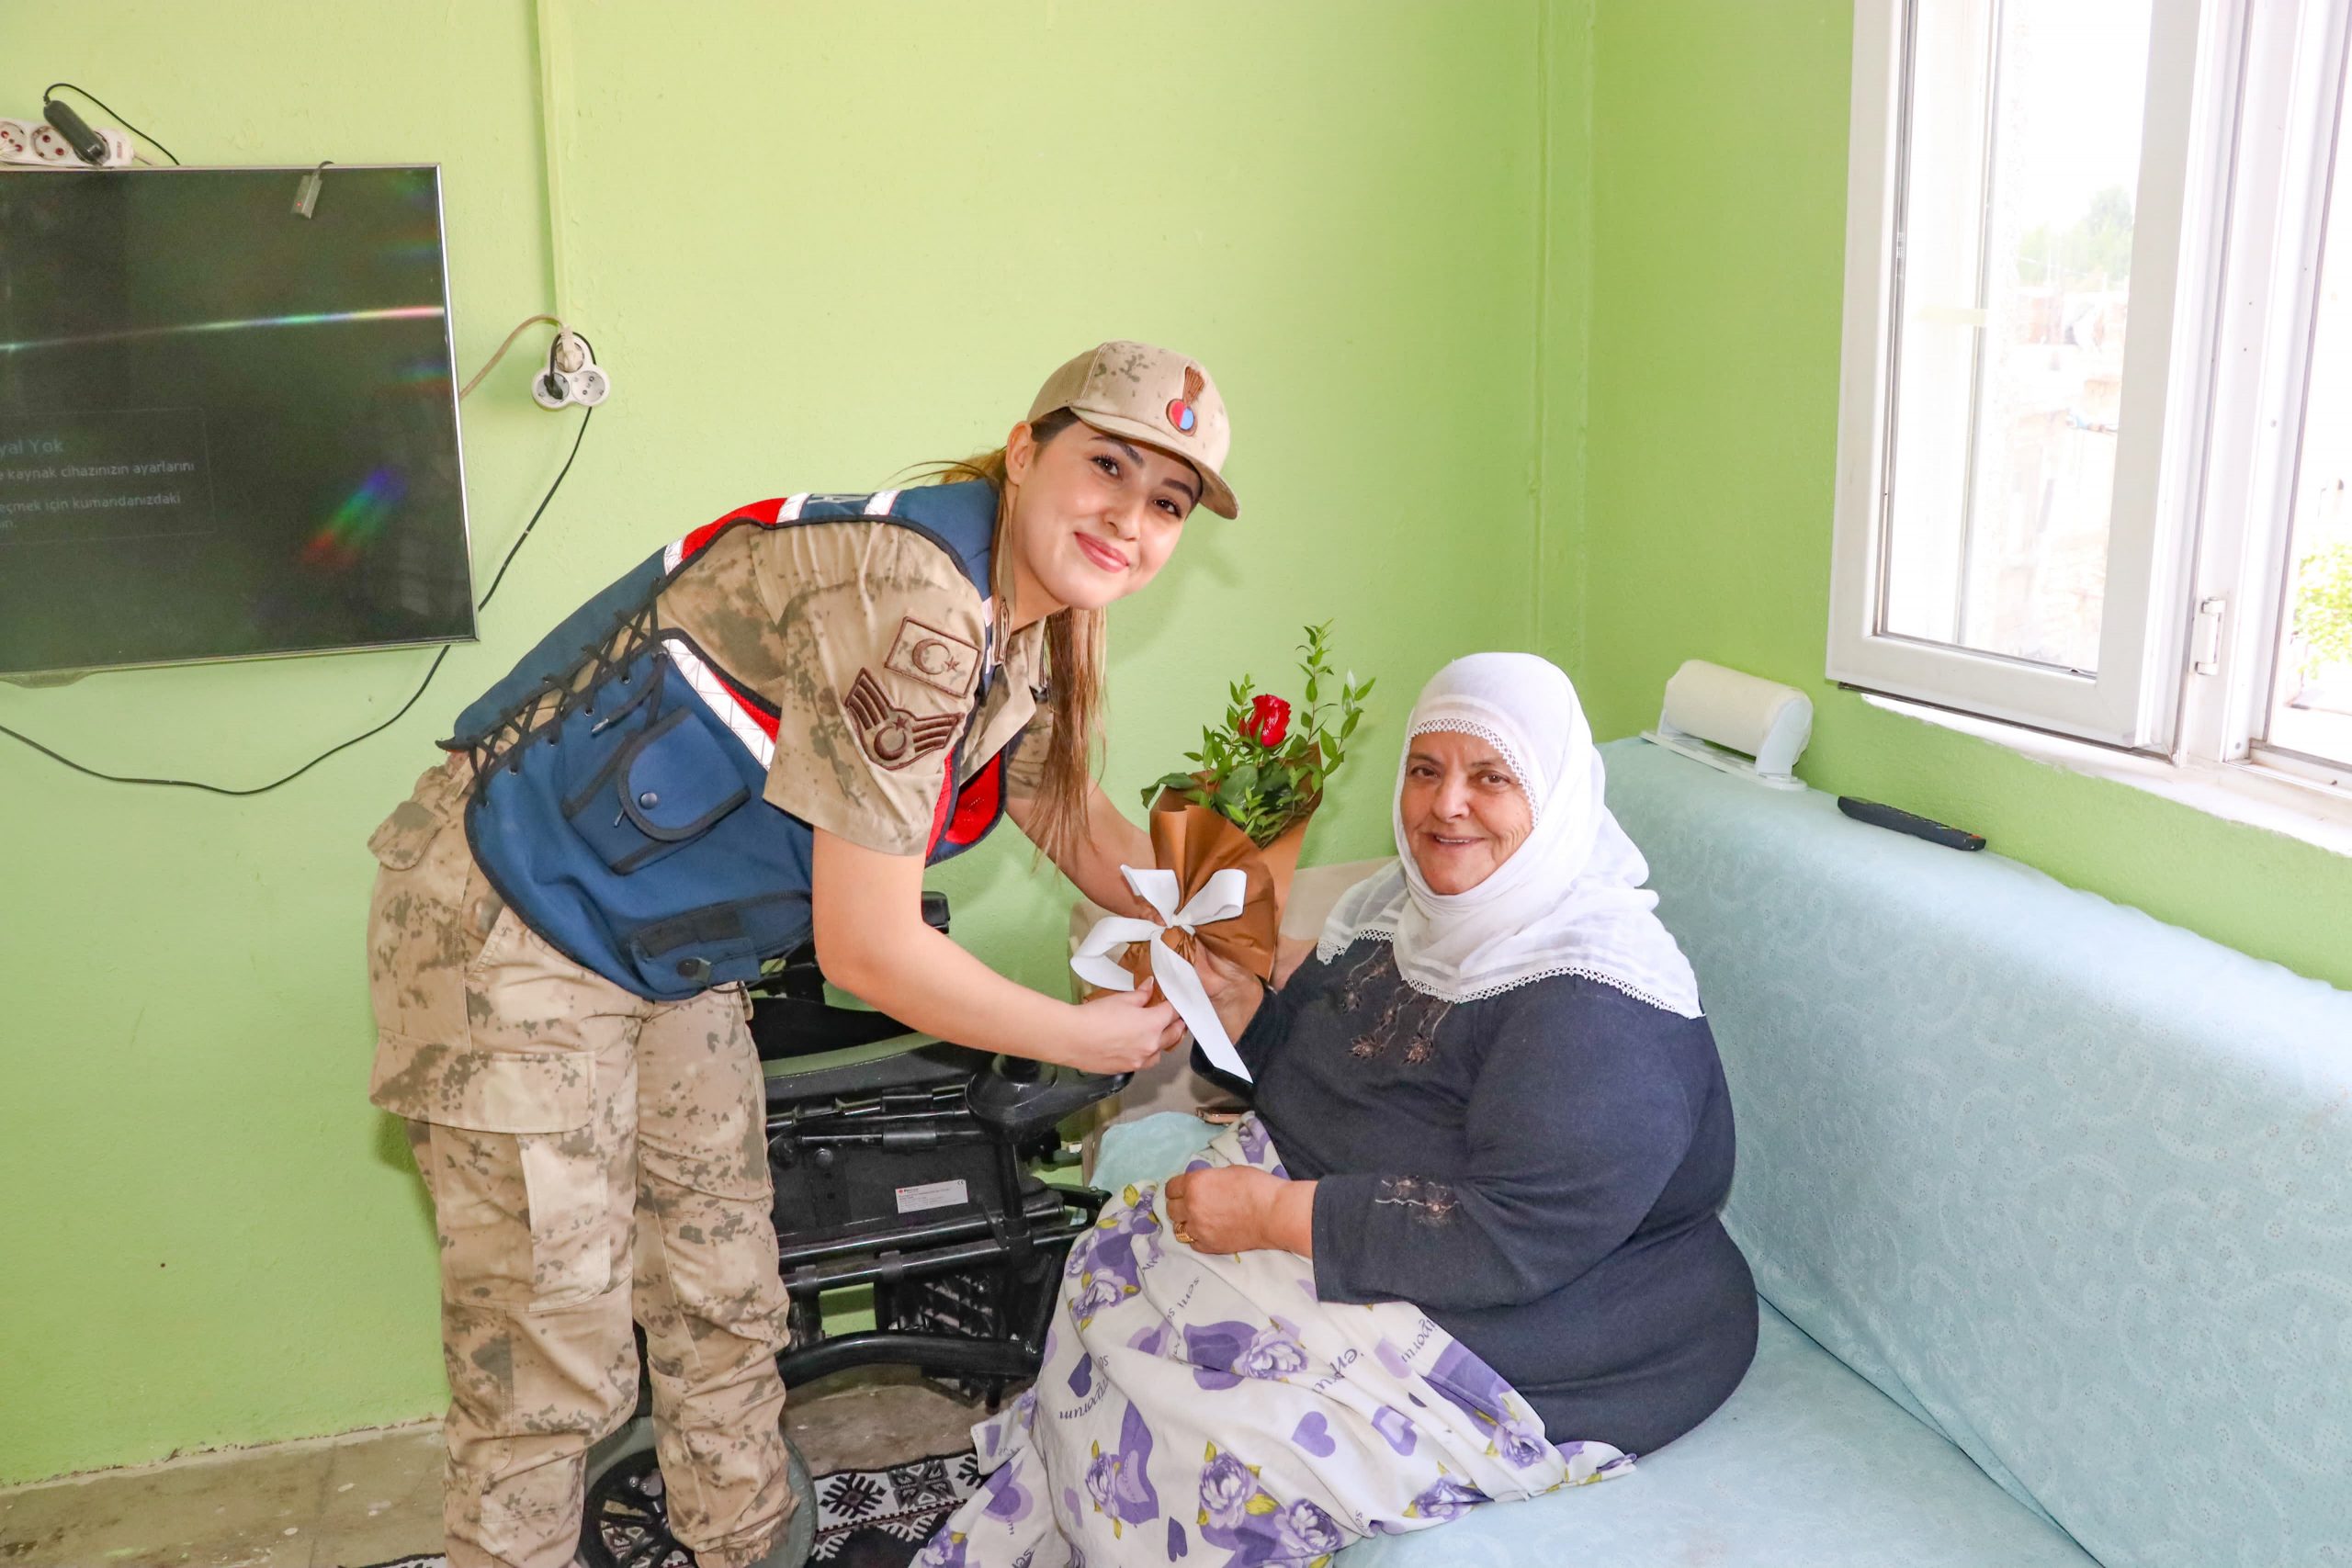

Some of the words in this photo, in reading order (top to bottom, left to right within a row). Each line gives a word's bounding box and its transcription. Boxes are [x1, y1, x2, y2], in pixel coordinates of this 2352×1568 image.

[28, 437, 64, 454] Yok
[7, 466, 57, 482] kaynak
[73, 491, 181, 510] kumandanızdaki
